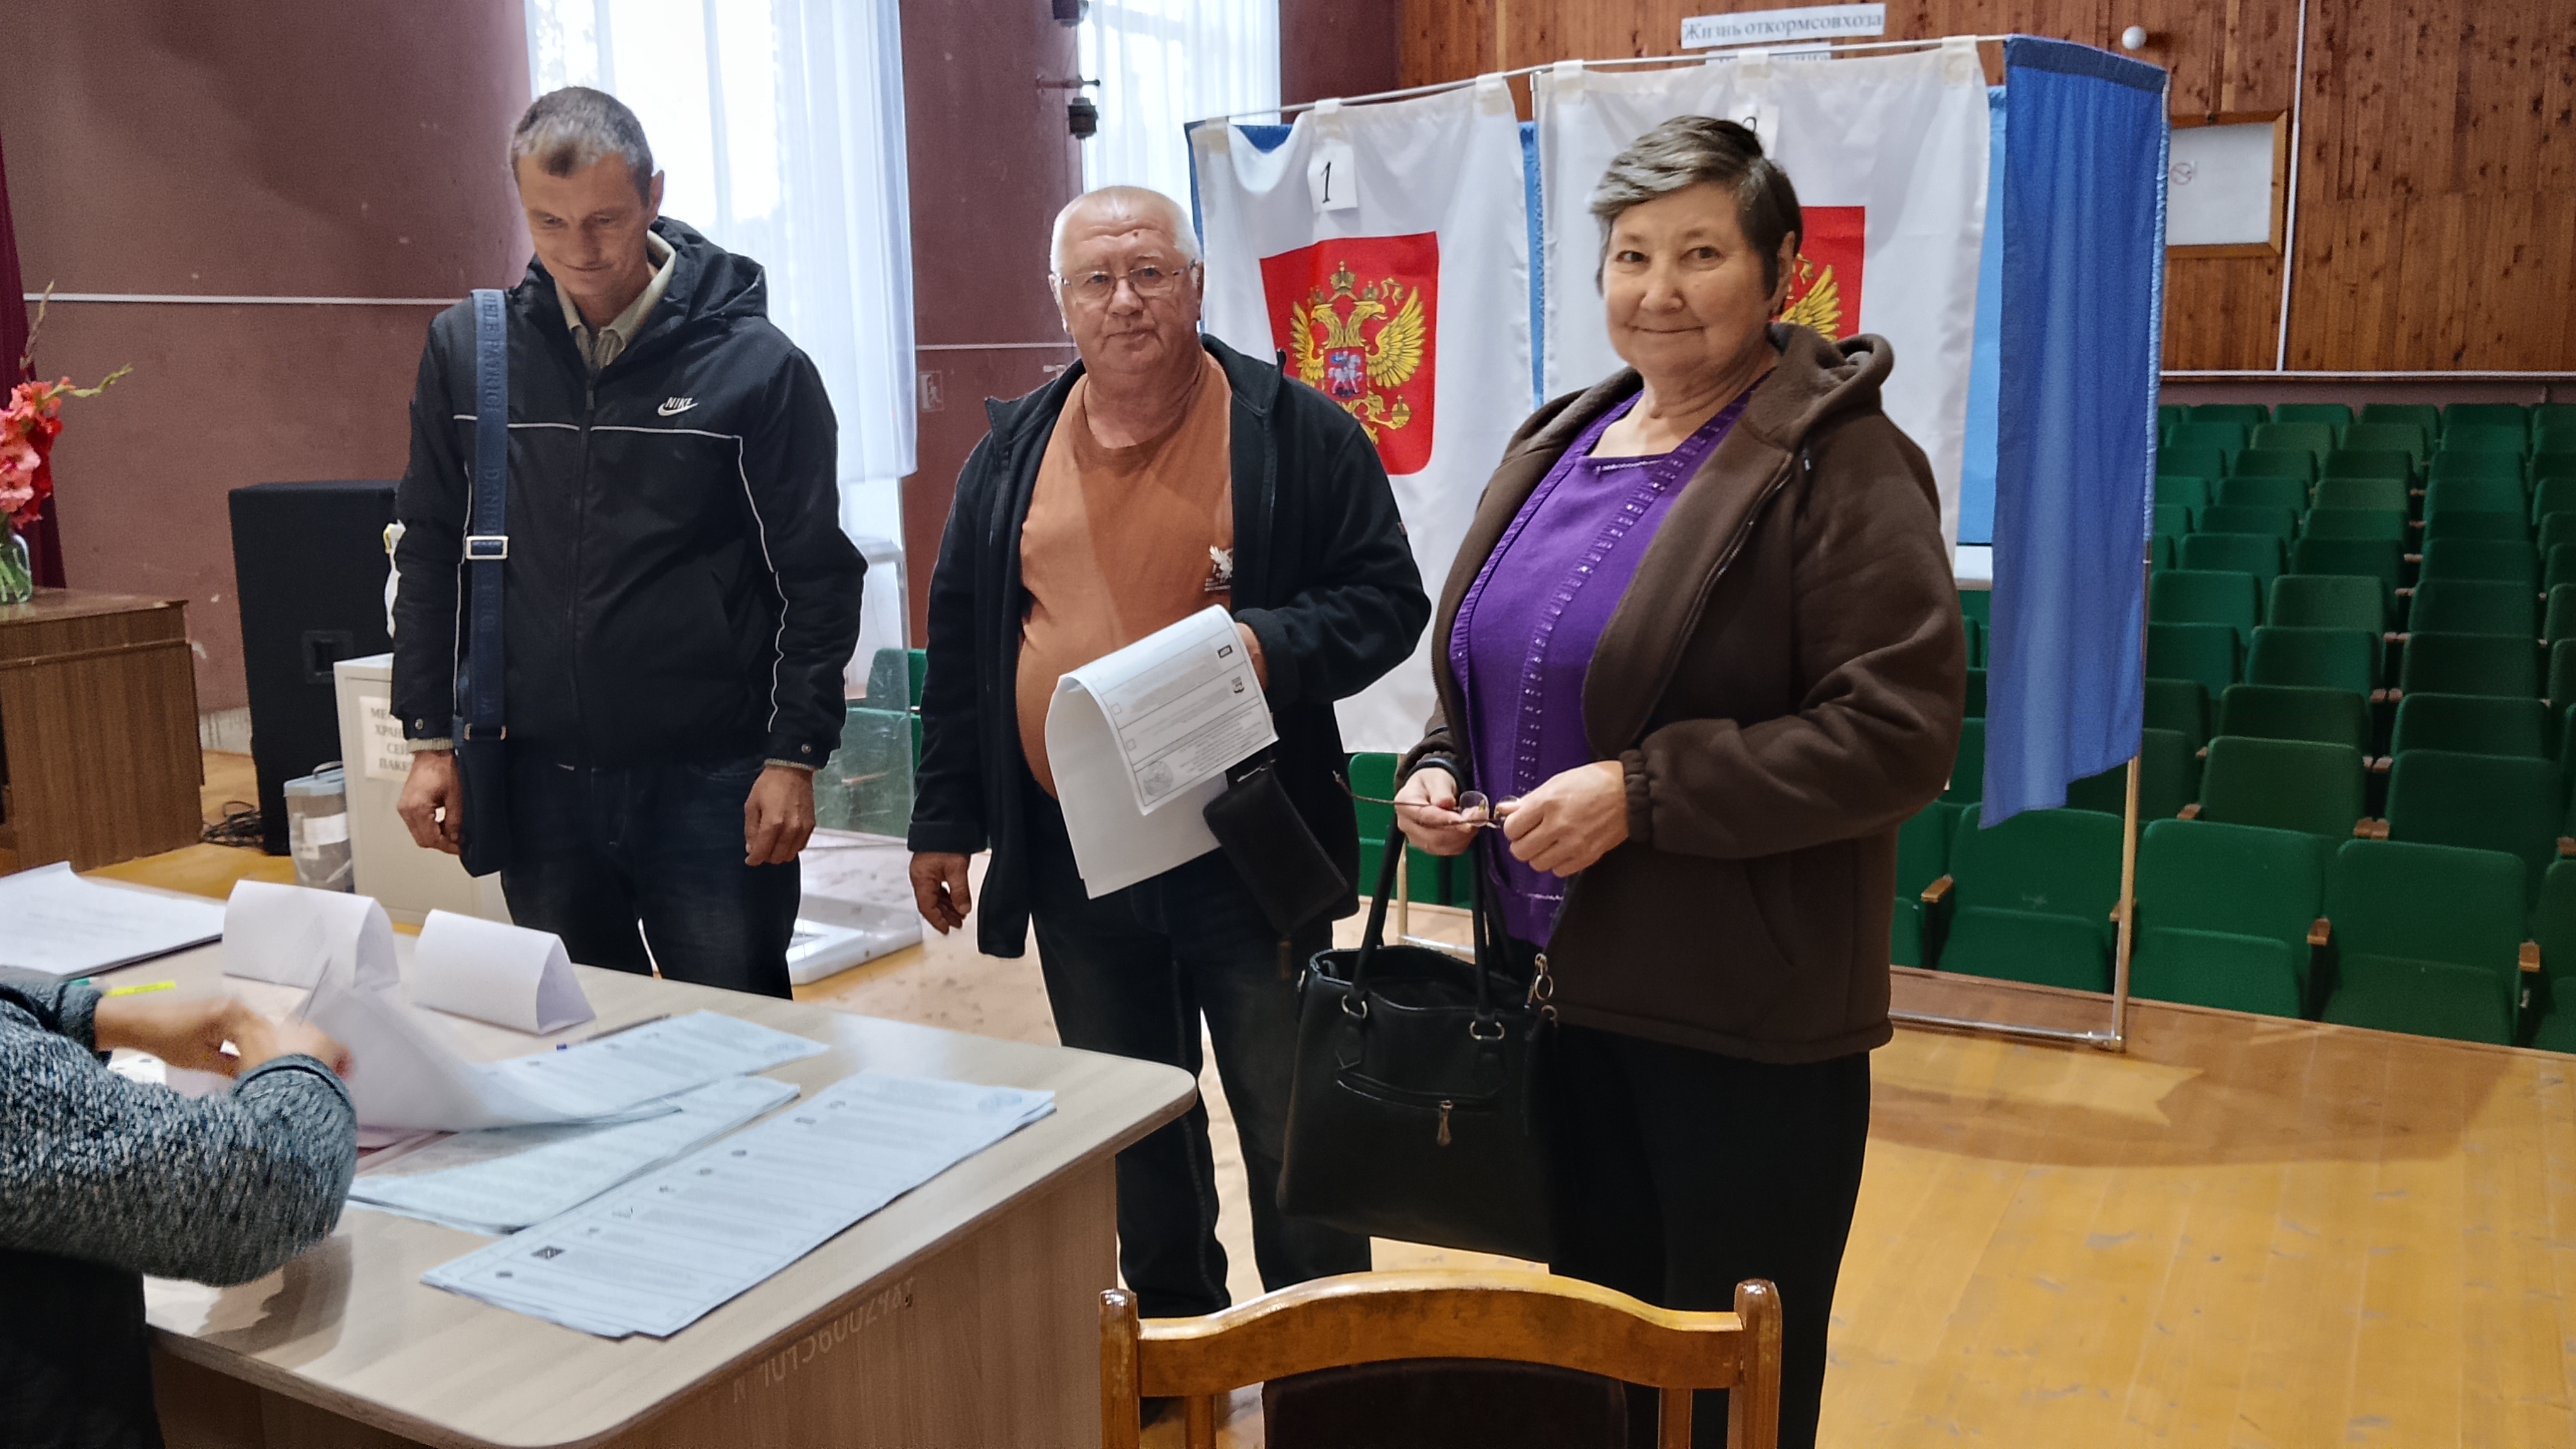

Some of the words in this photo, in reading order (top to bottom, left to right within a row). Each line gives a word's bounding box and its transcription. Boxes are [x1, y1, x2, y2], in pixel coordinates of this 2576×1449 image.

[1684, 23, 1741, 40] Жизнь
[1745, 14, 1882, 36] откормсовхоза
[1321, 161, 1331, 204] 1
[665, 397, 693, 409] NIKE
